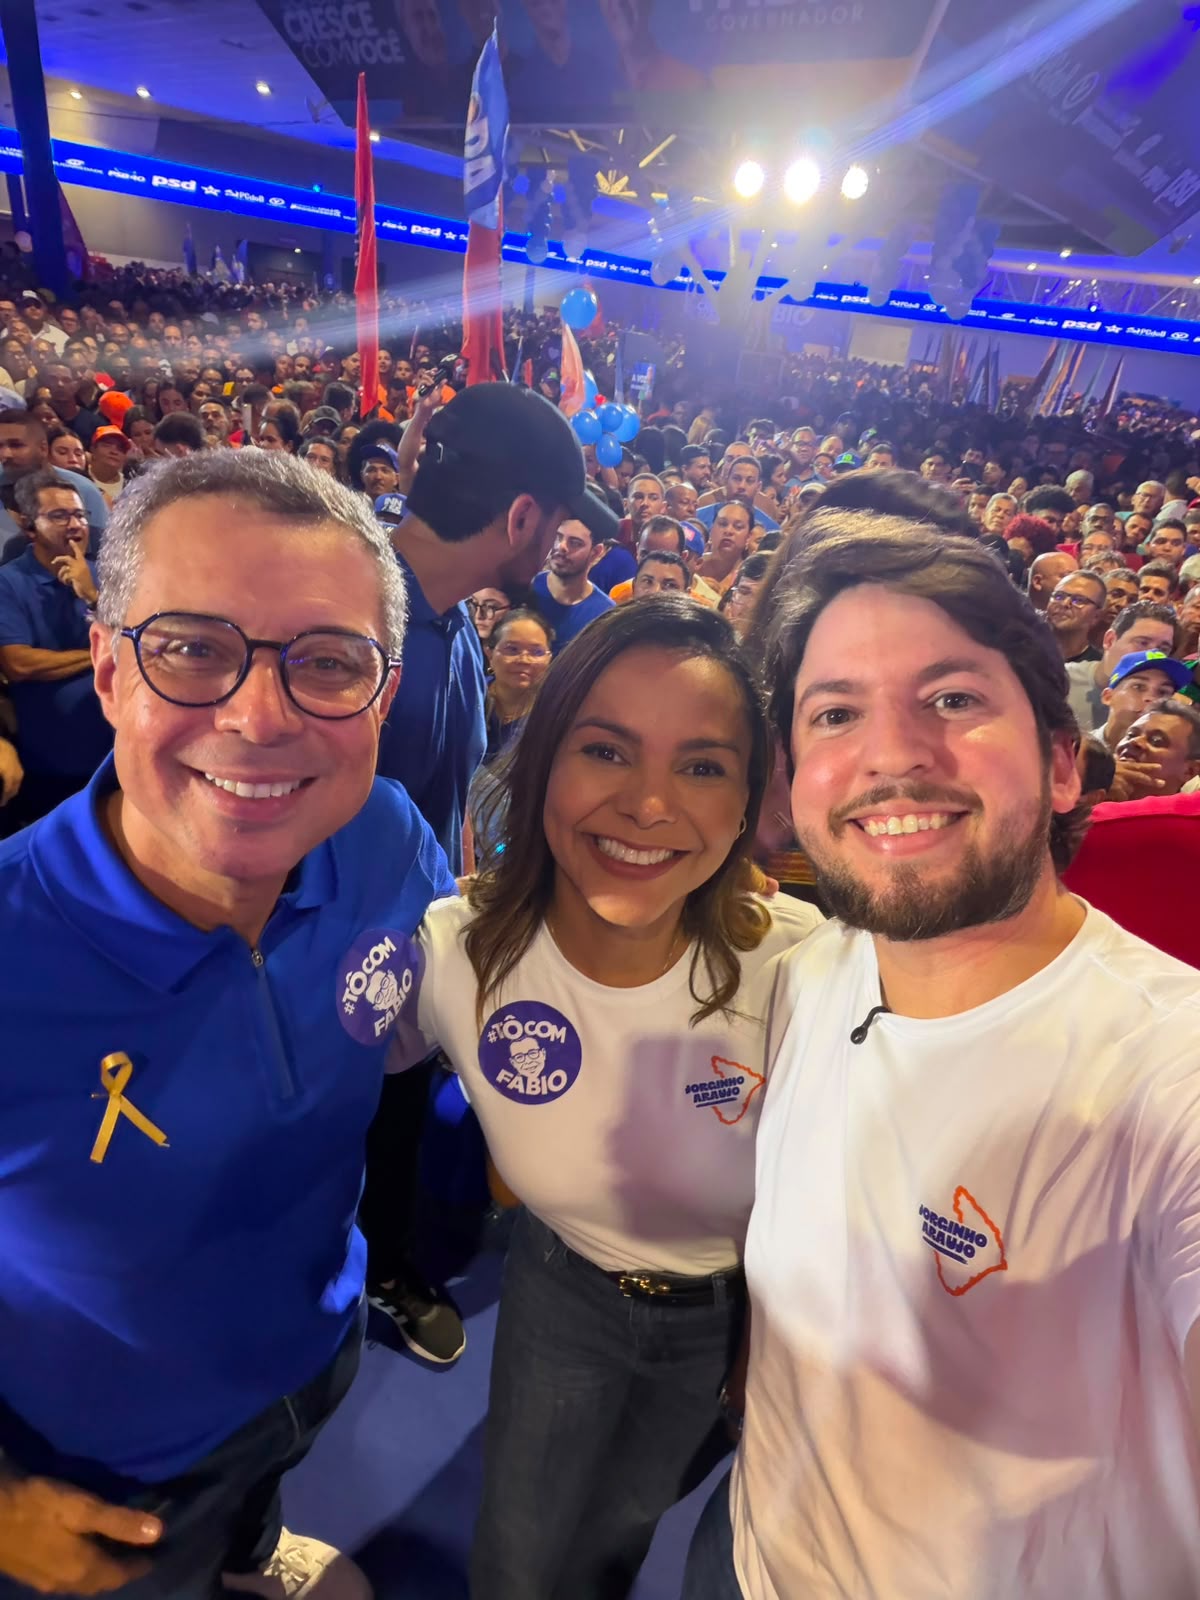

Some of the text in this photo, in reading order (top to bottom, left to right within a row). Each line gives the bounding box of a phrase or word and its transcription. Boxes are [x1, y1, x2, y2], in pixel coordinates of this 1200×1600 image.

[283, 1, 379, 42] CRESCE
[151, 175, 197, 192] psd
[410, 224, 442, 238] psd
[585, 258, 608, 269] psd
[1061, 319, 1102, 332] psd
[684, 1075, 745, 1095] JORGINHO
